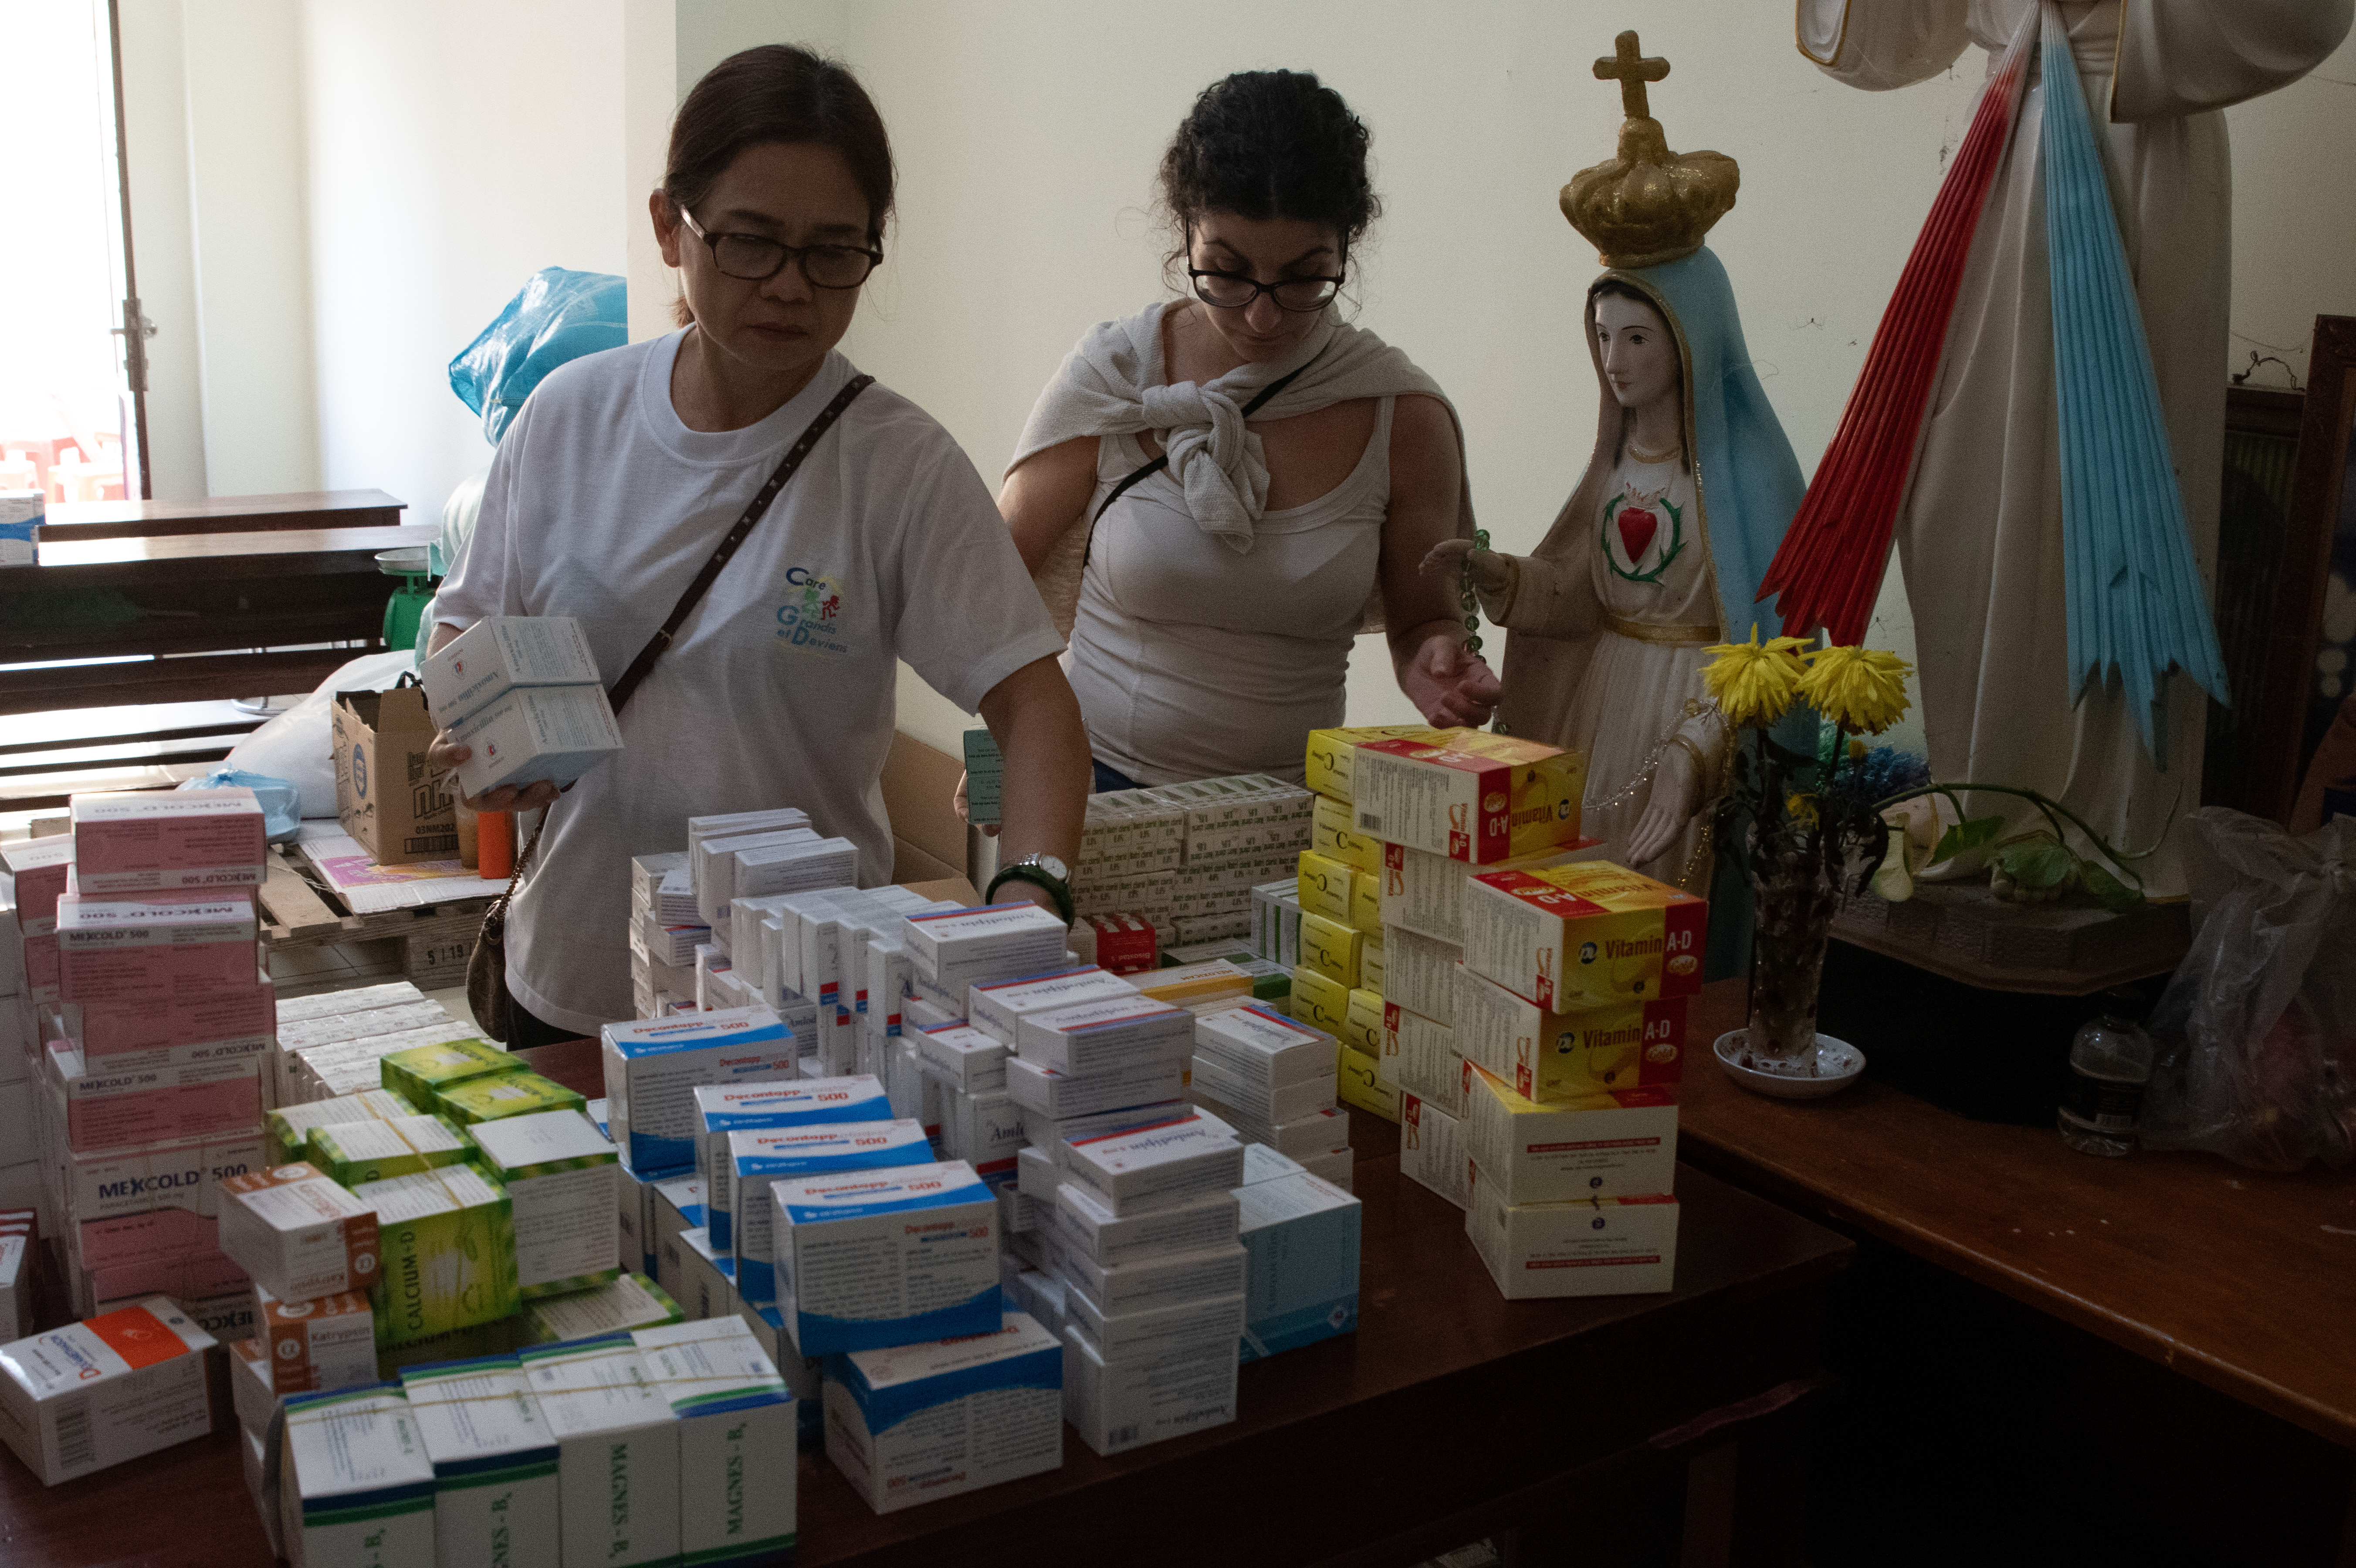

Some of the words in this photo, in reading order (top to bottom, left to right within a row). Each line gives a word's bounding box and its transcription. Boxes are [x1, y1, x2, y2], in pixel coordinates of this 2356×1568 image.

[786, 567, 826, 590] Care
[777, 605, 836, 634] Grandis
[791, 626, 847, 653] Deviens
[1324, 752, 1334, 771] C
[1511, 804, 1553, 830] Vitamin
[1336, 831, 1348, 849] C
[1317, 873, 1327, 892] C
[69, 930, 124, 941] MEXCOLD
[130, 929, 149, 938] 500
[1605, 935, 1662, 960] Vitamin
[427, 950, 435, 965] 5
[1117, 952, 1151, 962] Bisostad
[1320, 949, 1330, 967] C
[1180, 968, 1234, 981] MELOXICAM
[1313, 1004, 1324, 1022] C
[720, 1021, 749, 1030] 500
[1366, 1028, 1379, 1047] C
[1583, 1024, 1641, 1049] Vitamin
[773, 1059, 790, 1070] 500
[79, 1077, 131, 1090] MEXCOLD
[138, 1074, 157, 1084] 500
[1363, 1068, 1375, 1087] C
[818, 1092, 849, 1102] 500
[855, 1137, 888, 1146] 500
[98, 1170, 200, 1199] MEXCOLD
[212, 1163, 248, 1180] 500
[908, 1181, 942, 1191] 500
[969, 1226, 989, 1238] 500
